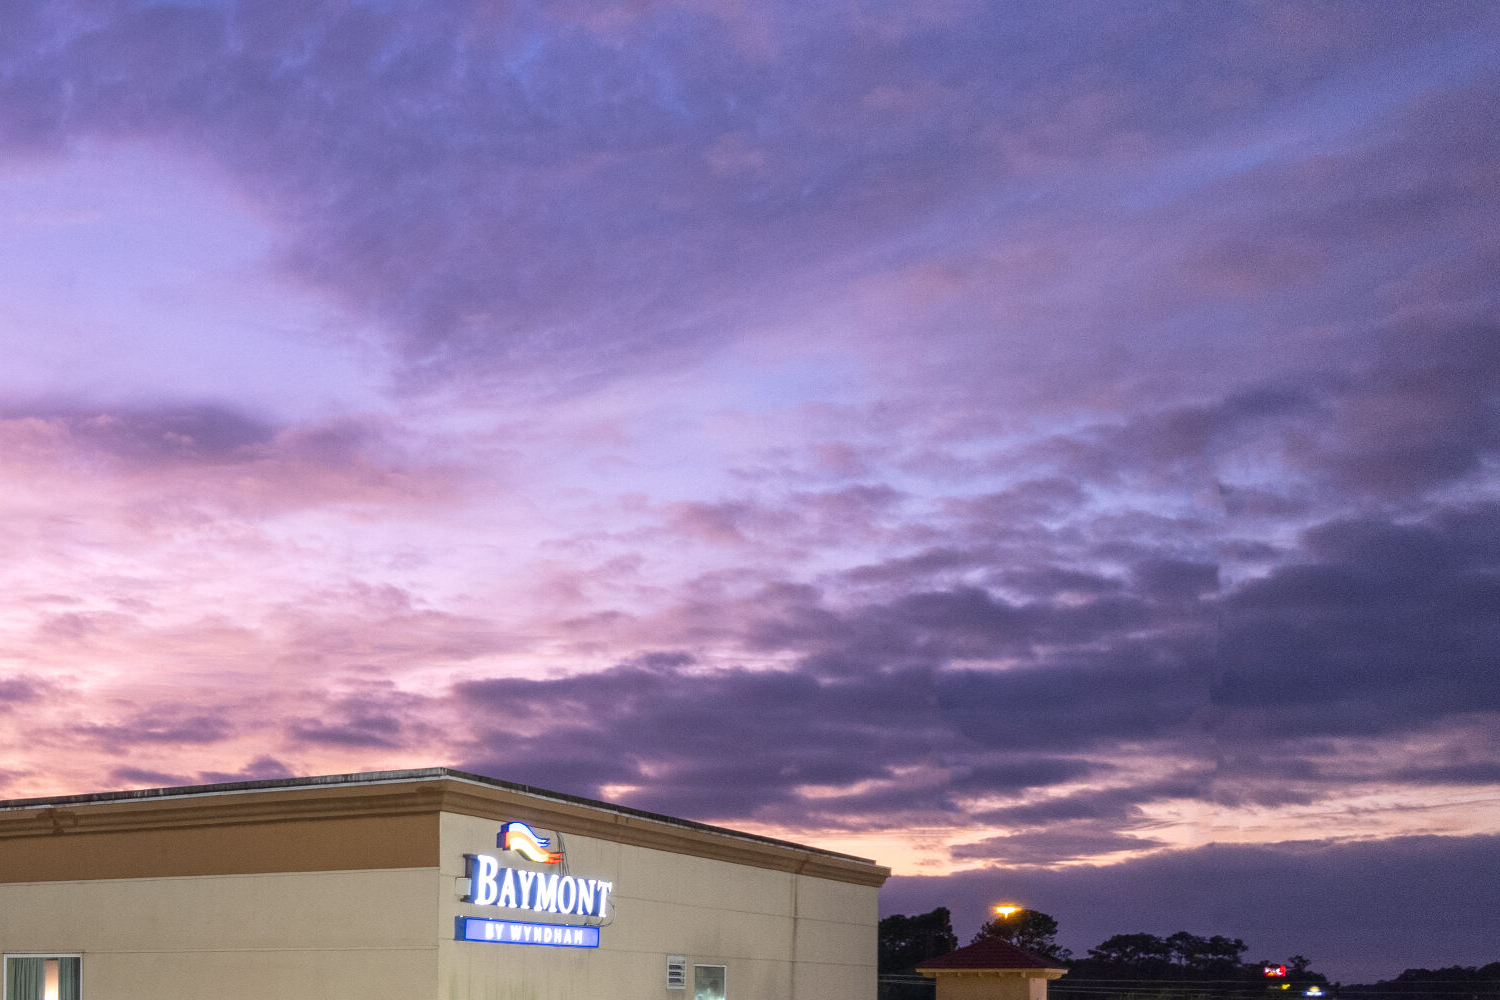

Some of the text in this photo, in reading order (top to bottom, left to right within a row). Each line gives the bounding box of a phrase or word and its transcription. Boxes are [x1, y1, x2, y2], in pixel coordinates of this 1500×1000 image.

[473, 854, 613, 918] BAYMONT
[484, 922, 584, 945] BY WYNDHAM
